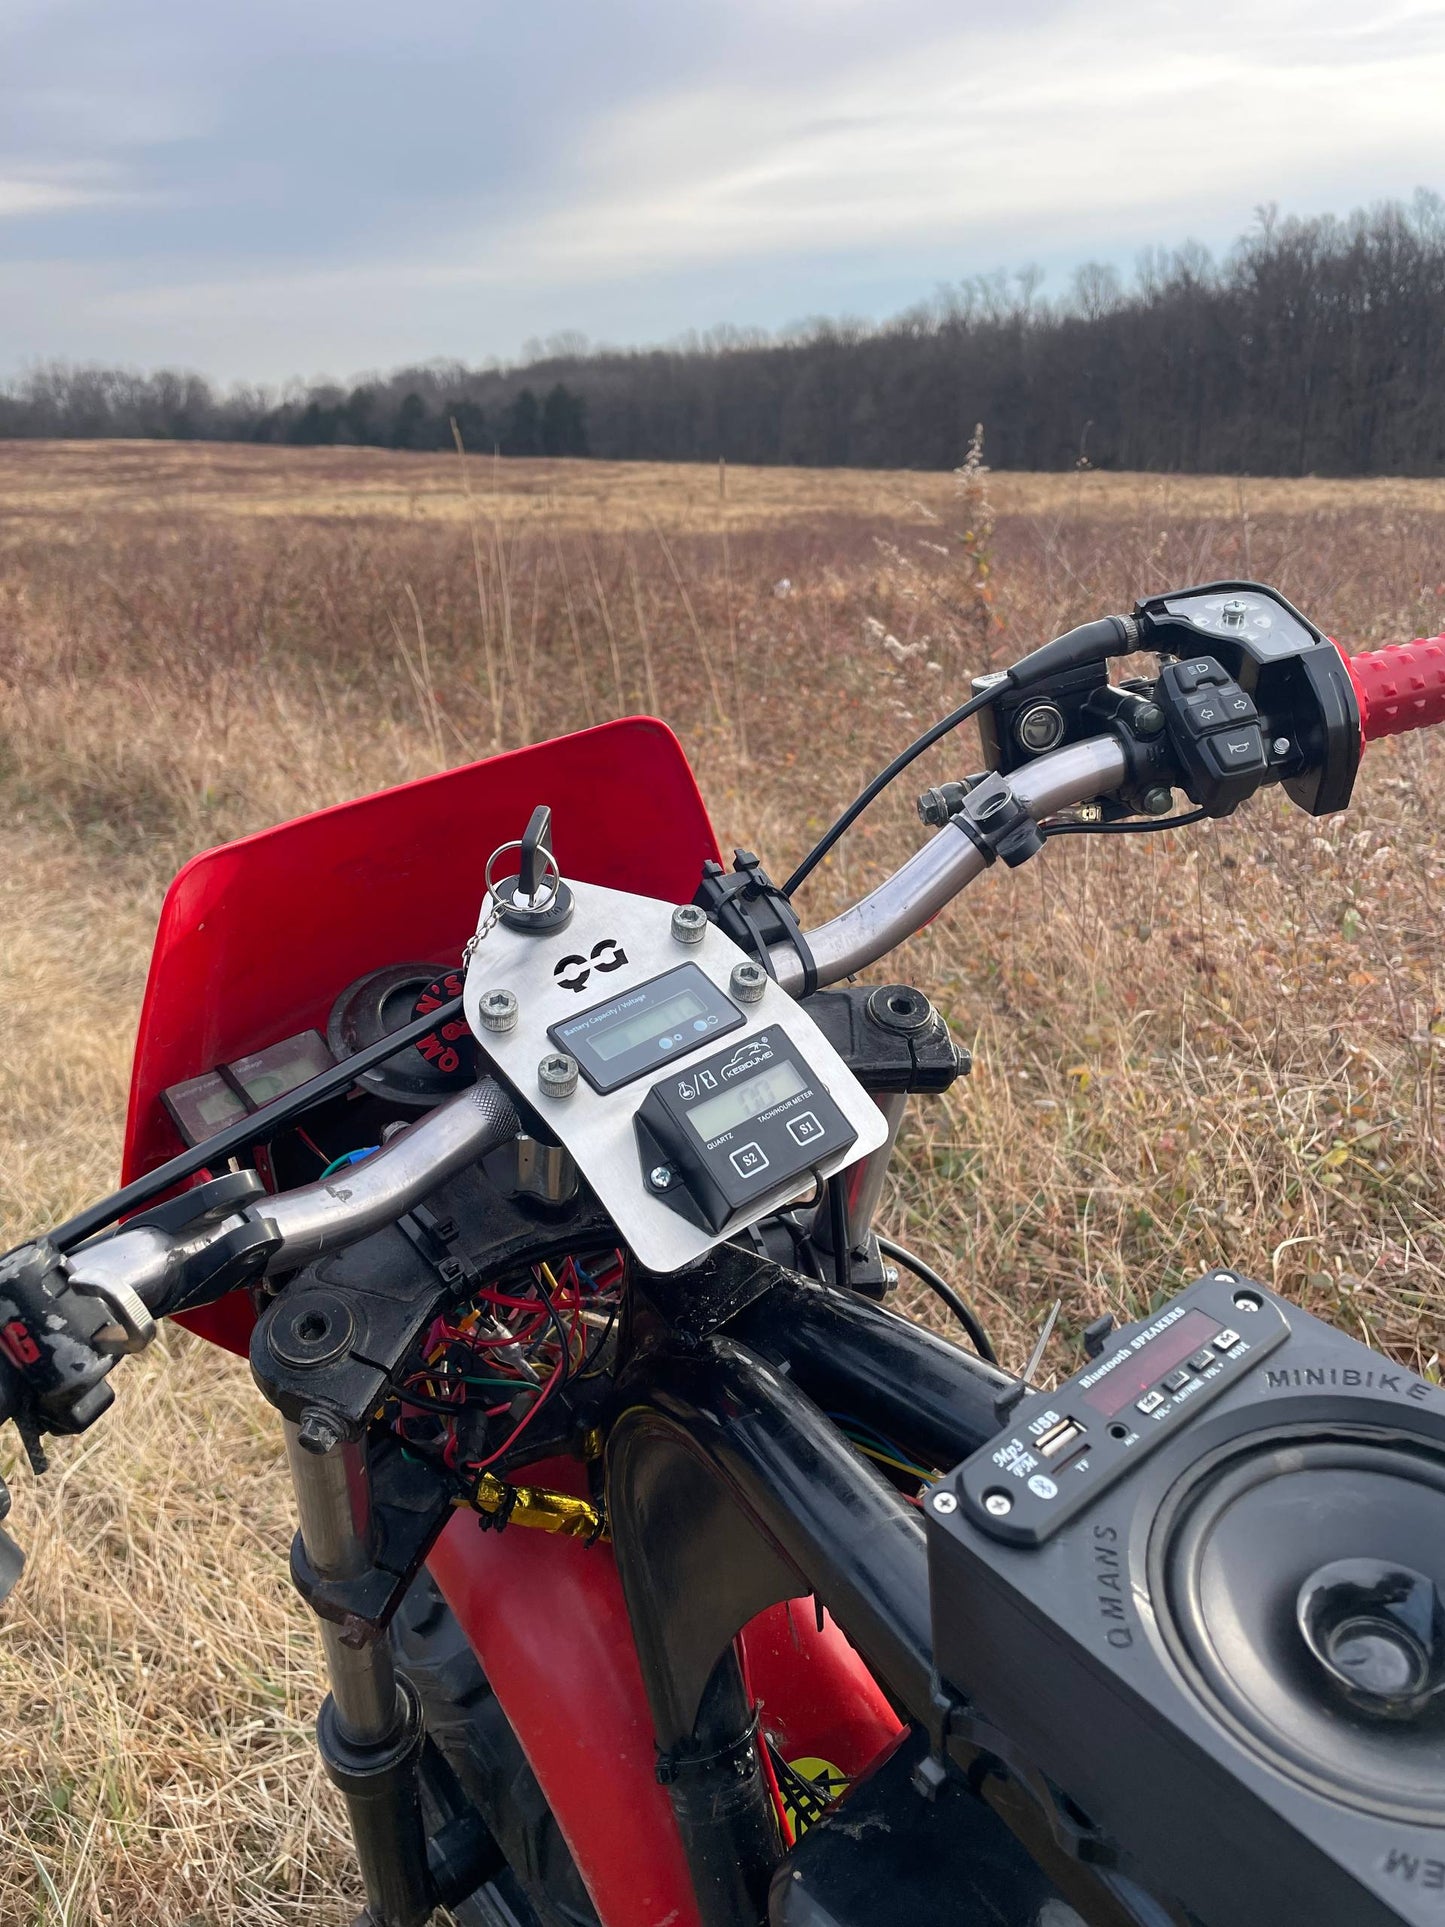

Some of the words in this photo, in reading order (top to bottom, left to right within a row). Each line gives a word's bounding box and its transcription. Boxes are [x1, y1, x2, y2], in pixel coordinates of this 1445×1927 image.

[554, 939, 629, 993] QG
[415, 974, 463, 1073] QMN'S
[563, 1021, 590, 1037] Battery
[589, 1007, 618, 1025] Capacity
[621, 994, 647, 1008] Voltage
[726, 1050, 774, 1078] KEBIDUMEI
[757, 1100, 793, 1123] TACH/HOUR
[791, 1089, 814, 1107] METER
[706, 1132, 734, 1150] QUARTZ
[799, 1121, 814, 1135] S1
[742, 1152, 758, 1166] S2
[1078, 1348, 1132, 1389] Bluetooth
[1130, 1306, 1186, 1350] SPEAKERS
[1266, 1367, 1432, 1401] MINIBIKE
[1028, 1410, 1060, 1435] USB
[992, 1438, 1024, 1468] Mp3
[1012, 1455, 1039, 1478] FM
[1074, 1458, 1090, 1473] TF
[1093, 1524, 1134, 1650] QMANS
